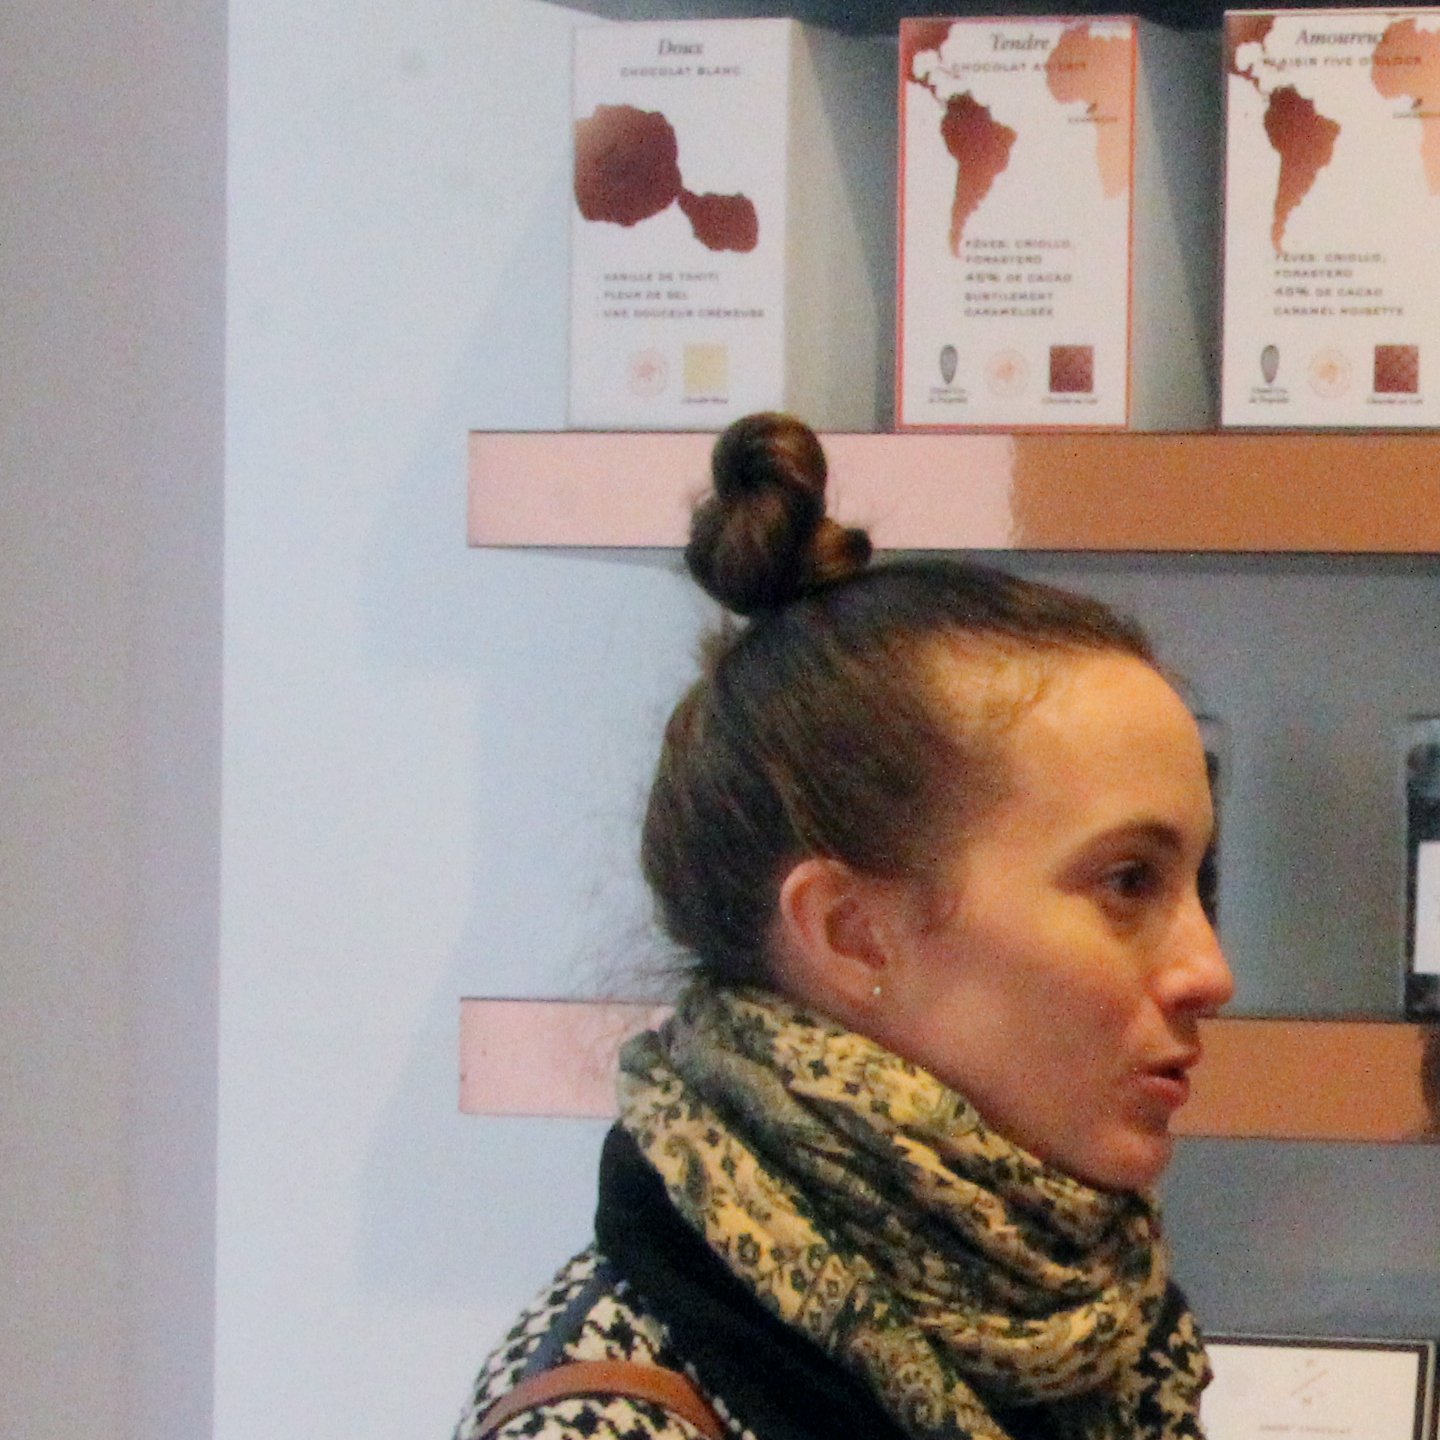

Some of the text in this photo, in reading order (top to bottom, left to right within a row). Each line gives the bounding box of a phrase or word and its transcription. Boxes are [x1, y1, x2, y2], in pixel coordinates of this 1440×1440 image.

[990, 33, 1051, 52] Tendre
[620, 66, 691, 77] CHOCOLAT
[951, 61, 1026, 73] CHOCOLAT
[1006, 274, 1023, 283] DE
[1028, 273, 1073, 283] CACAO
[1315, 288, 1332, 297] DE
[1338, 287, 1384, 297] CACAO
